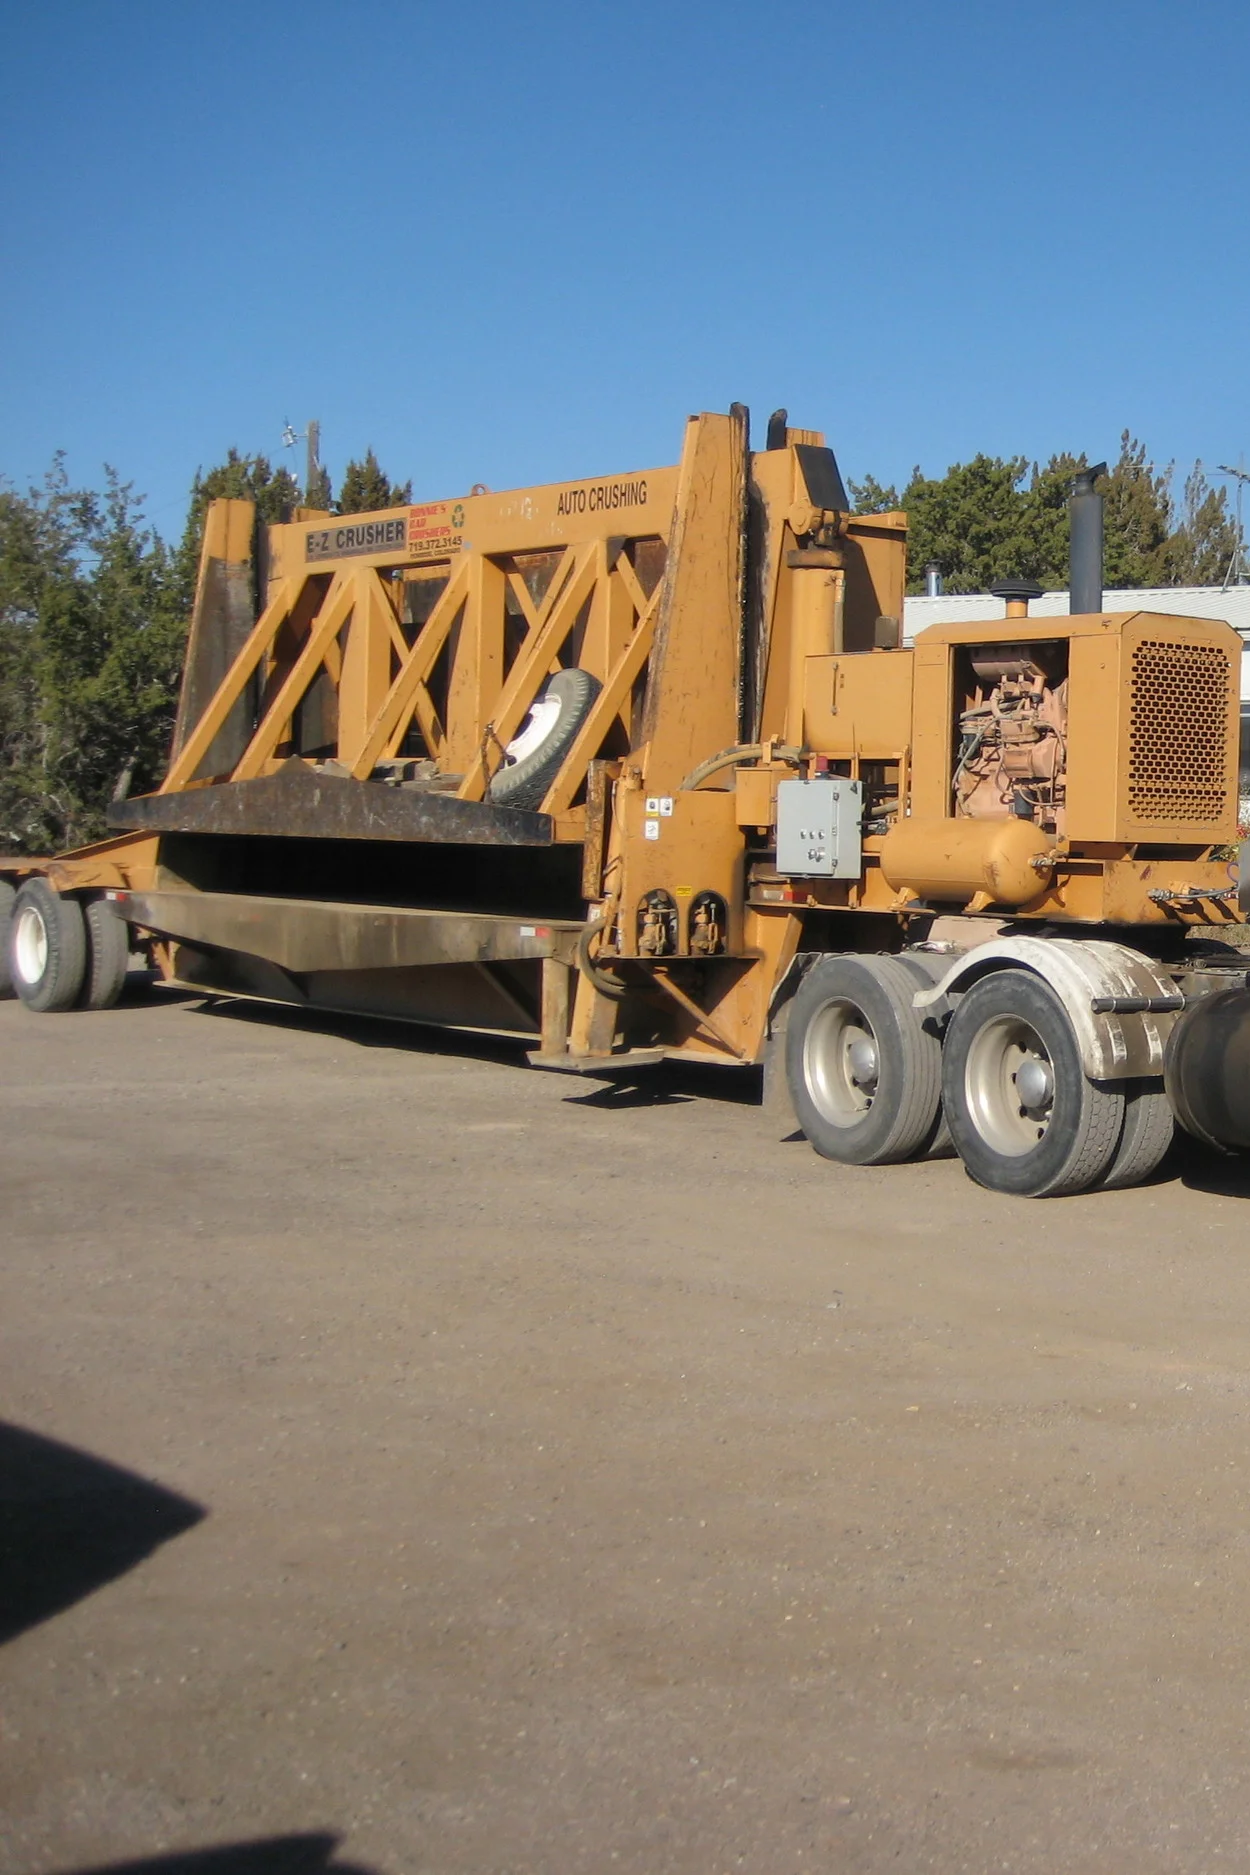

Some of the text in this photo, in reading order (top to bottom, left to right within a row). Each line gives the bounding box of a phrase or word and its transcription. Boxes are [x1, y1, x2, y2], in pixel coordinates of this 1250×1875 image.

[557, 489, 586, 516] AUTO
[589, 480, 647, 511] CRUSHING
[306, 532, 329, 553] E-Z
[336, 520, 405, 549] CRUSHER
[409, 536, 463, 552] 719.372.3145
